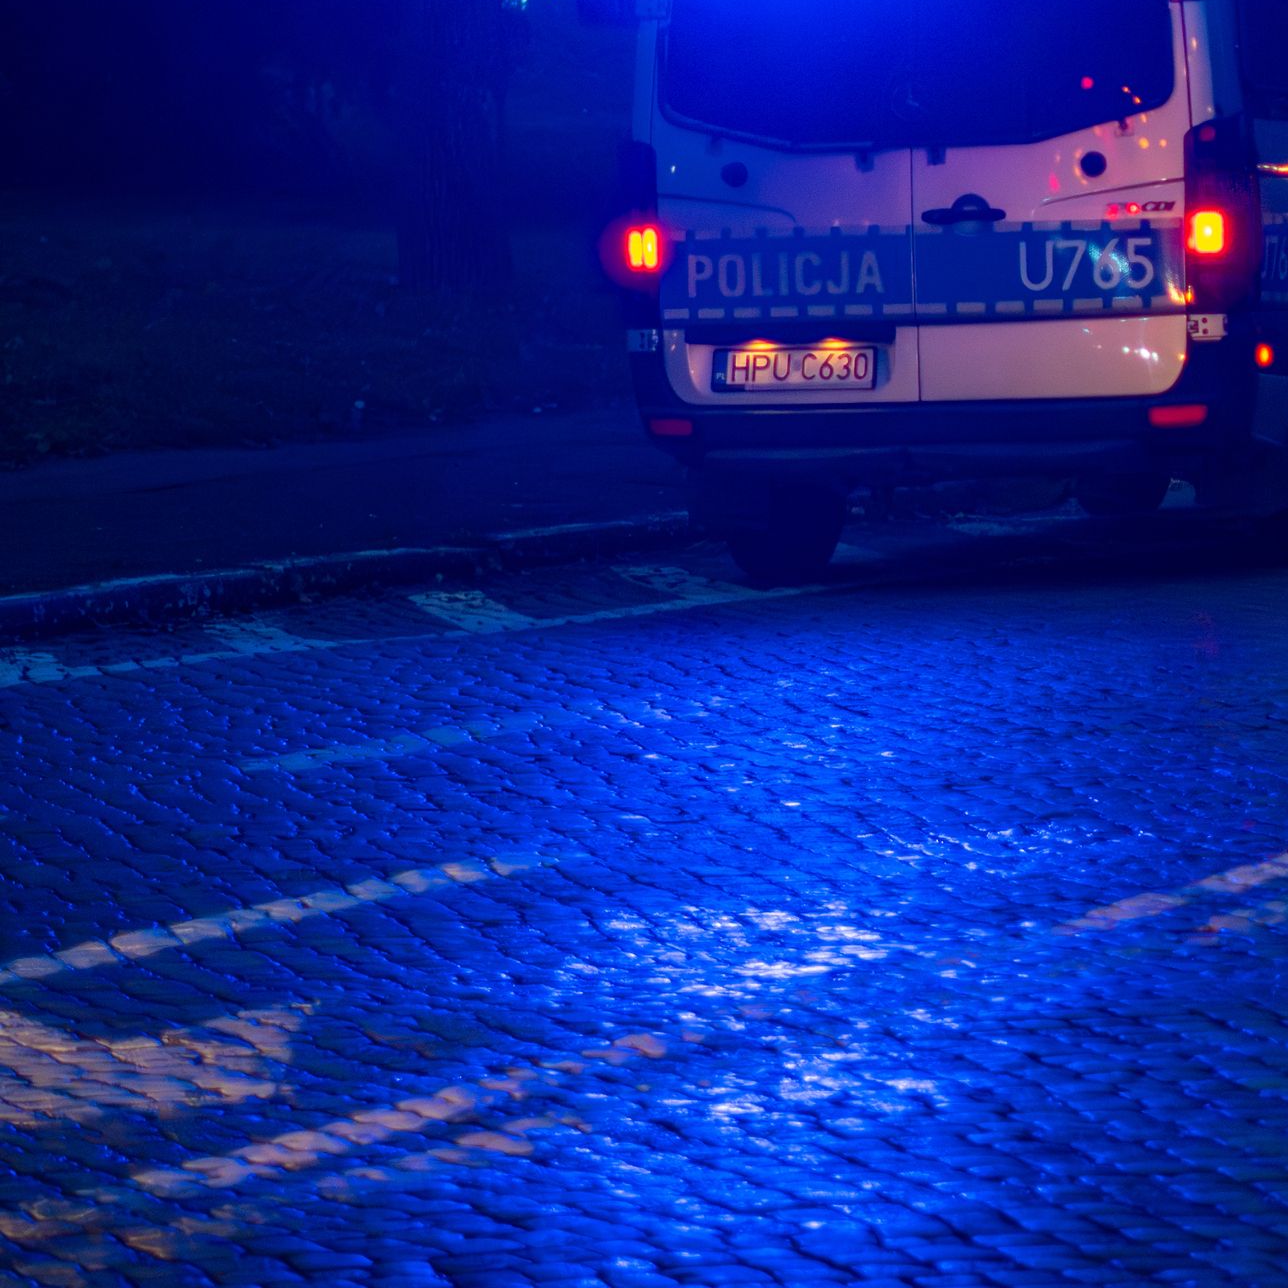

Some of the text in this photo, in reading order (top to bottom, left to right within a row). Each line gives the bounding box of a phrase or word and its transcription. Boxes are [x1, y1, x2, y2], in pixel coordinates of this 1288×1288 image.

[687, 250, 886, 299] POLICJA
[1018, 237, 1155, 292] U765
[731, 352, 869, 382] HPU C630
